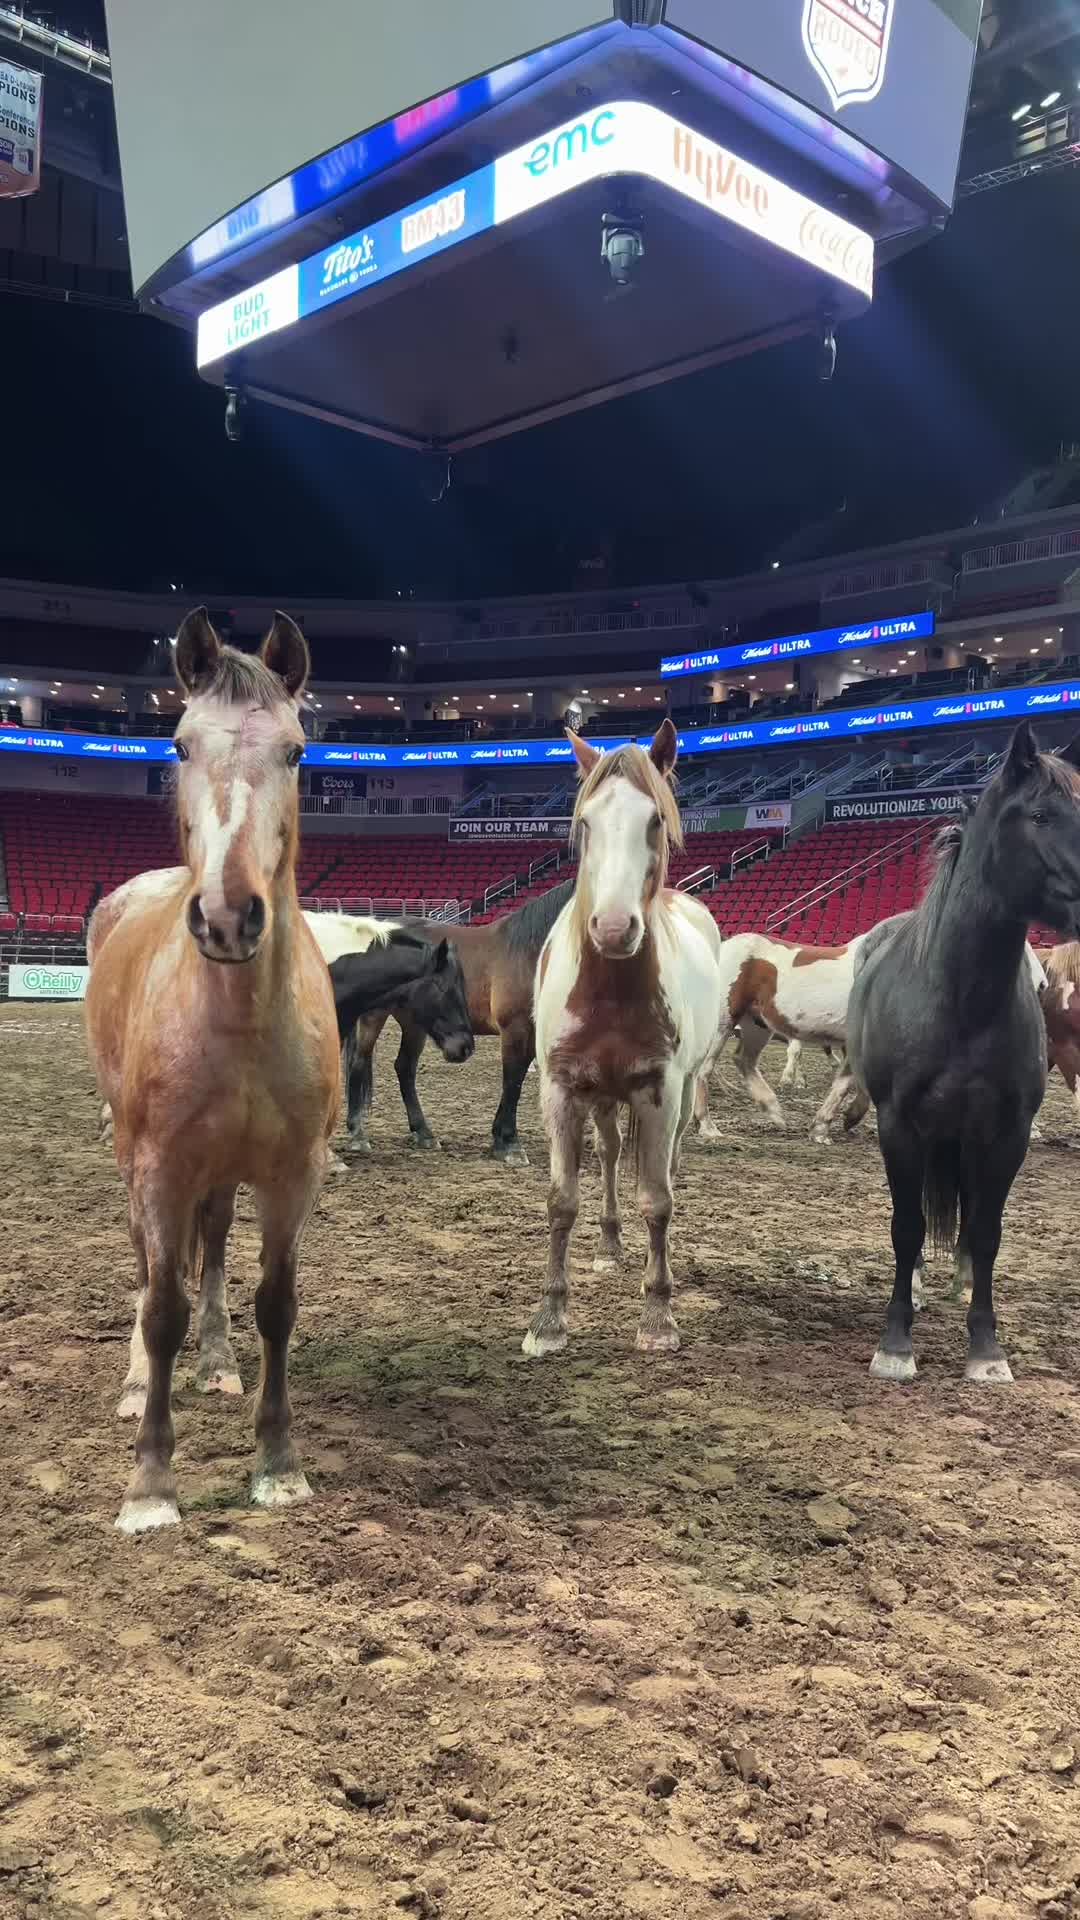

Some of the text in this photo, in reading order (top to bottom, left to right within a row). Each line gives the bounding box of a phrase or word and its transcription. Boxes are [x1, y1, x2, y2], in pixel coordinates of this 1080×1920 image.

[522, 109, 617, 177] emc
[322, 234, 375, 284] Tito's
[233, 292, 265, 321] BUD
[226, 309, 271, 346] LIGHT
[880, 621, 916, 637] ULTRA
[779, 639, 811, 653] ULTRA
[690, 654, 719, 668] ULTRA
[972, 699, 1005, 712] ULTRA
[883, 710, 913, 723] ULTRA
[802, 720, 830, 732] ULTRA
[728, 730, 754, 741] ULTRA
[33, 738, 64, 748] ULTRA
[117, 744, 147, 754] ULTRA
[358, 752, 387, 761] ULTRA
[432, 751, 459, 760] ULTRA
[502, 748, 529, 758] ULTRA
[755, 807, 784, 819] WM
[833, 799, 926, 818] REVOLUTIONIZE
[454, 823, 481, 833] JOIN
[485, 822, 512, 833] OUR
[515, 822, 549, 832] TEAM
[24, 969, 82, 992] O'Reilly
